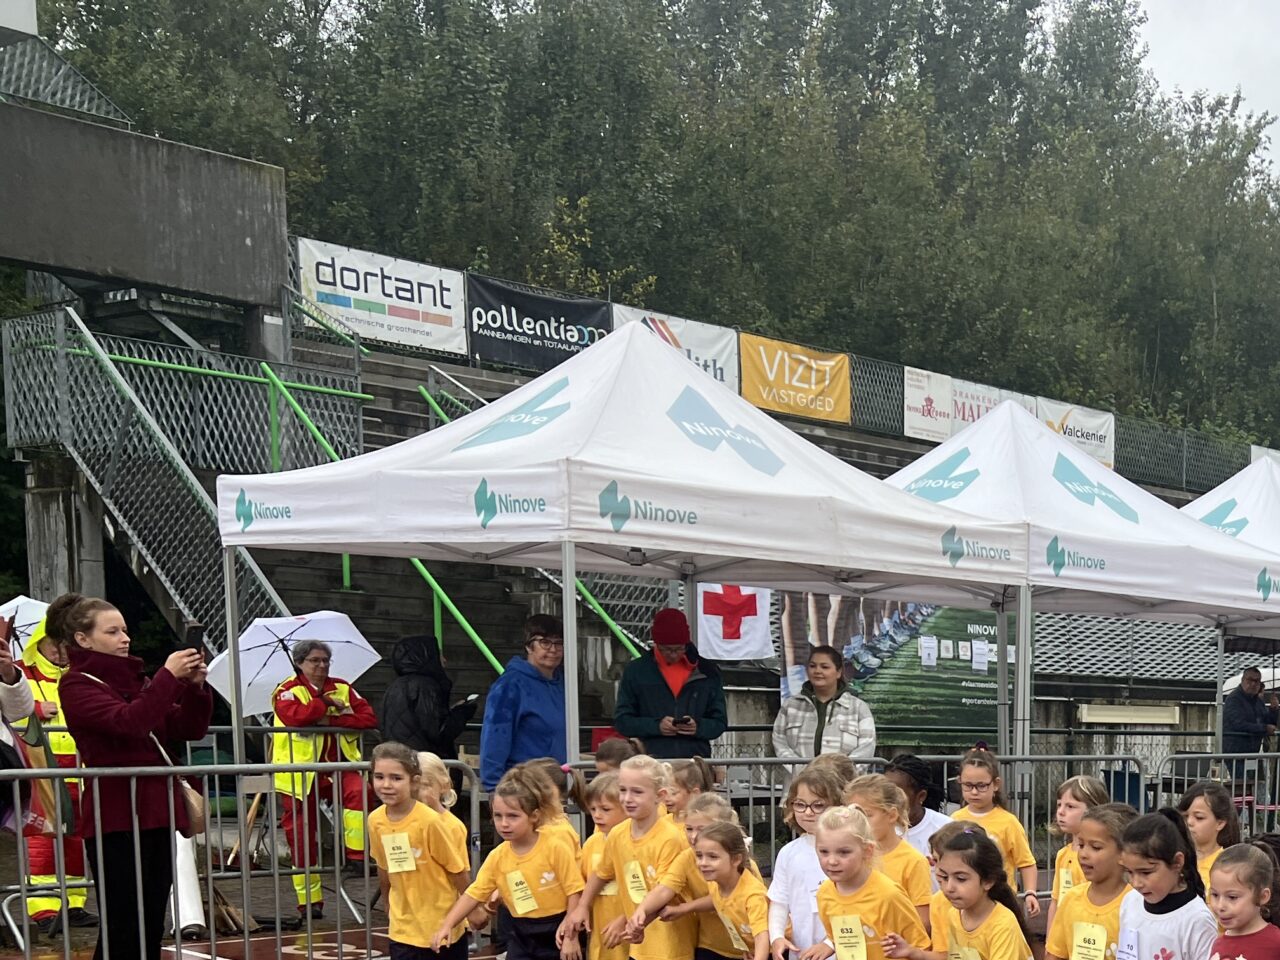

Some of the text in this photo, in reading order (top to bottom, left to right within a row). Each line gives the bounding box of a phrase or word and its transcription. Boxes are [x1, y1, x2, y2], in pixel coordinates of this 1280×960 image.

[315, 257, 451, 309] dortant
[387, 321, 433, 337] groothandel
[471, 305, 579, 342] pollentia
[478, 328, 532, 344] AANNEMINGEN
[759, 345, 836, 391] VIZIT
[758, 385, 835, 412] VASTGOED
[1061, 423, 1107, 444] Valckenier
[253, 501, 292, 519] Ninove
[497, 494, 546, 514] Ninove
[633, 499, 697, 525] Ninove
[965, 540, 1011, 561] Ninove
[1066, 551, 1106, 570] Ninove
[967, 624, 997, 636] NINOV
[1082, 937, 1096, 946] 663
[1126, 943, 1134, 951] 10
